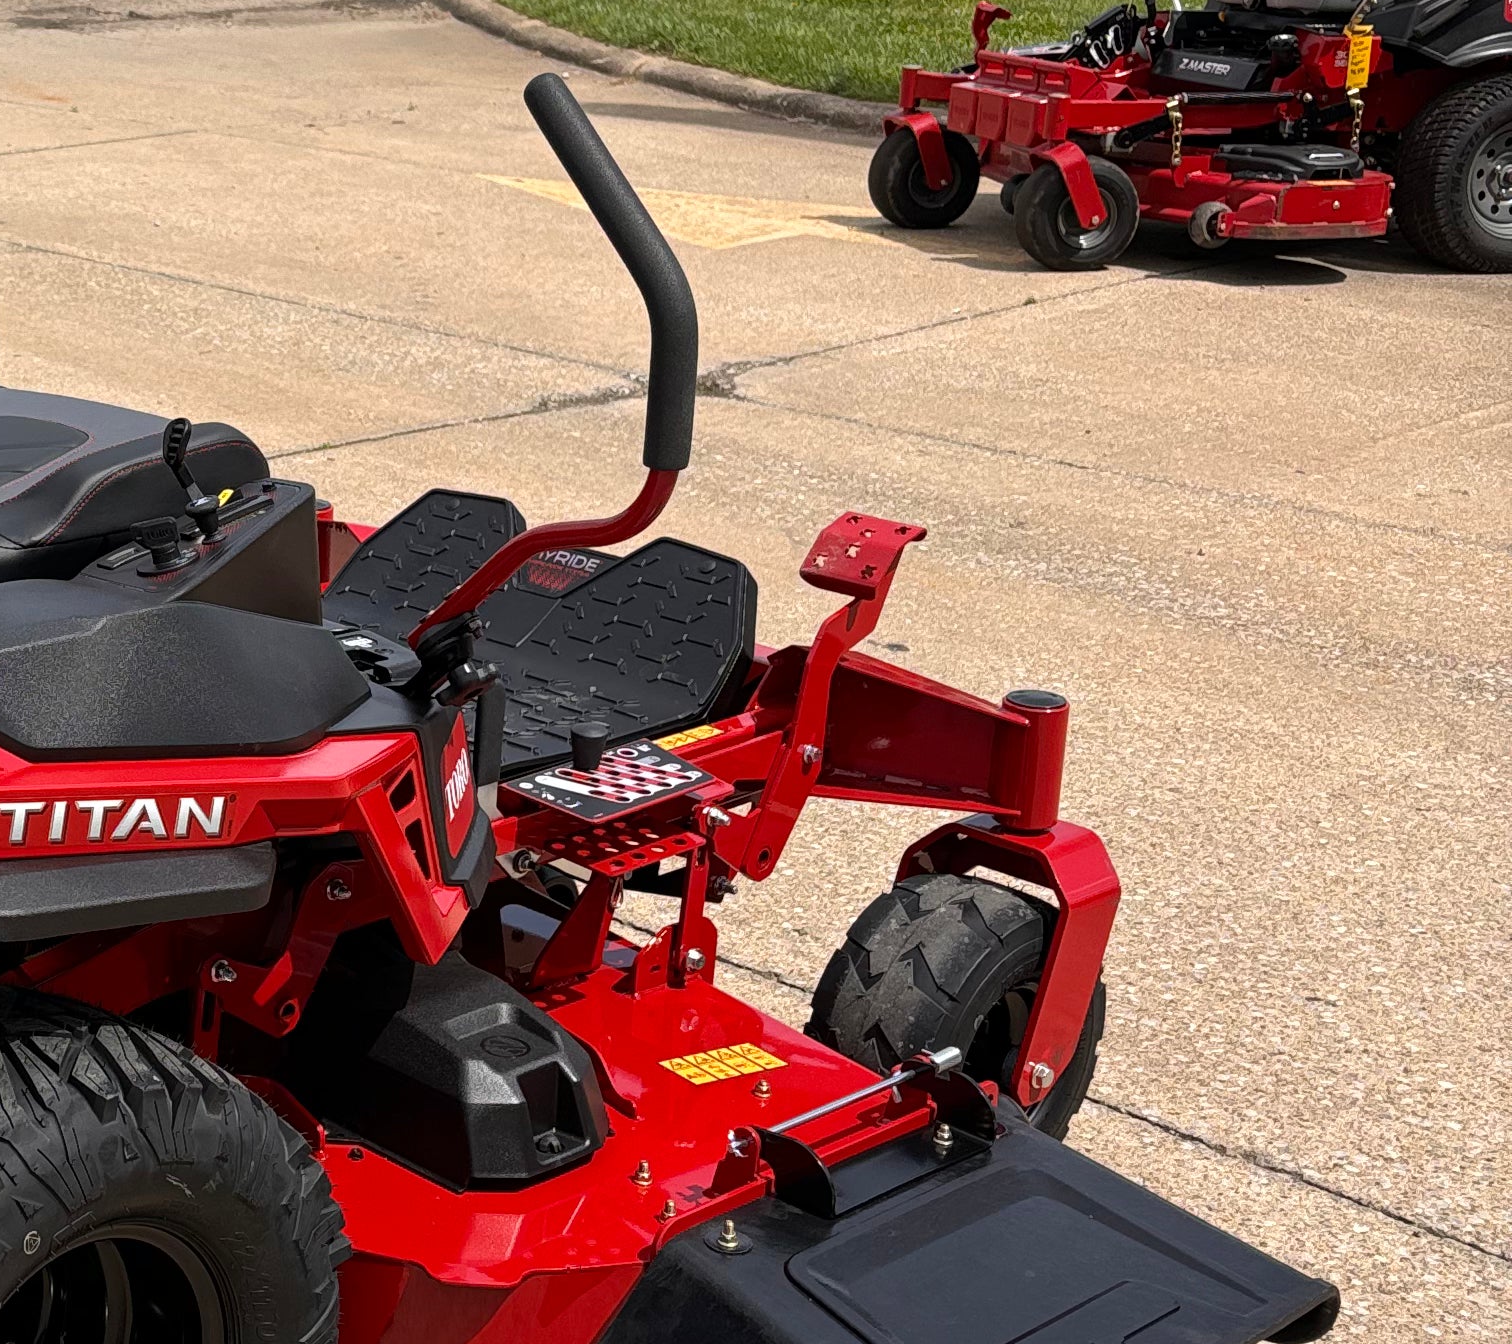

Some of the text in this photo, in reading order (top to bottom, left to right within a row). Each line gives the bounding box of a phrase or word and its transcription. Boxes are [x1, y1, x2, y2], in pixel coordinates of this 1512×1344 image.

[1187, 59, 1231, 76] MASTER
[538, 550, 600, 573] YRIDE
[445, 747, 470, 823] TORO
